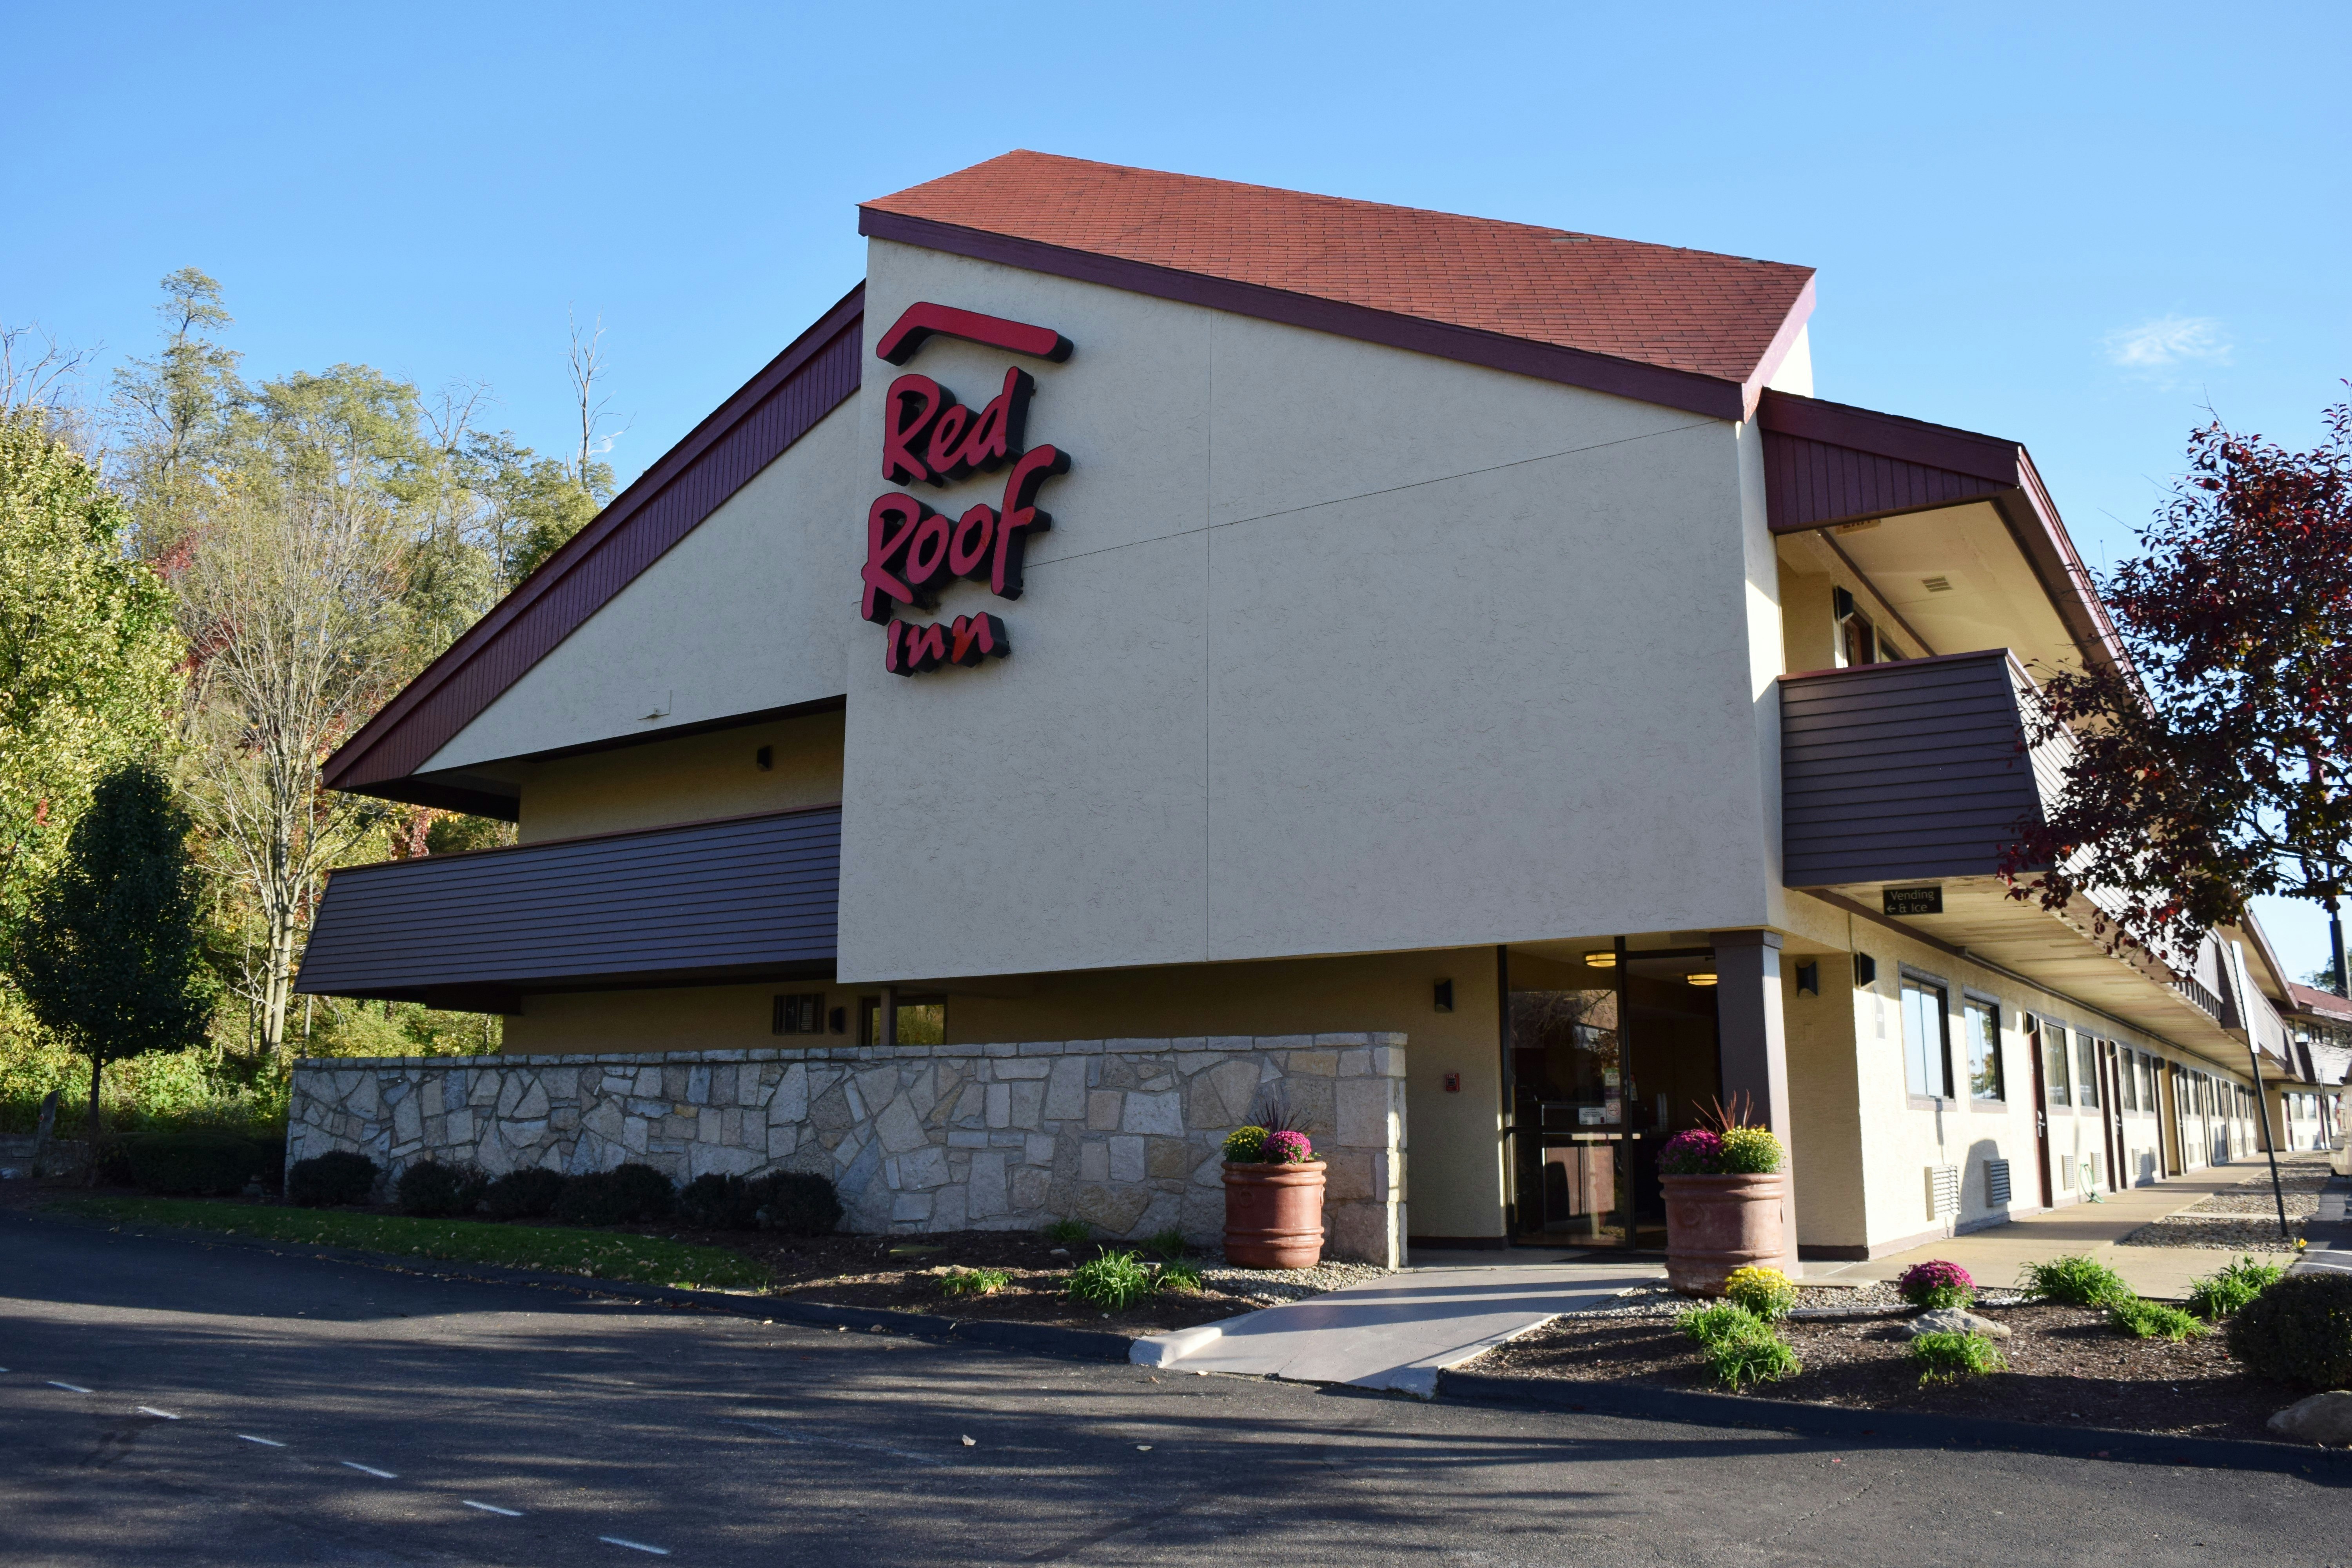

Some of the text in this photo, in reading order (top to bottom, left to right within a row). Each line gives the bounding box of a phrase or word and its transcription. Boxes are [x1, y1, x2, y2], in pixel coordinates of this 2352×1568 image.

[882, 366, 1022, 482] Red
[861, 444, 1057, 621] Roof
[1890, 889, 1935, 901] Vending
[1898, 903, 1928, 913] & Ice
